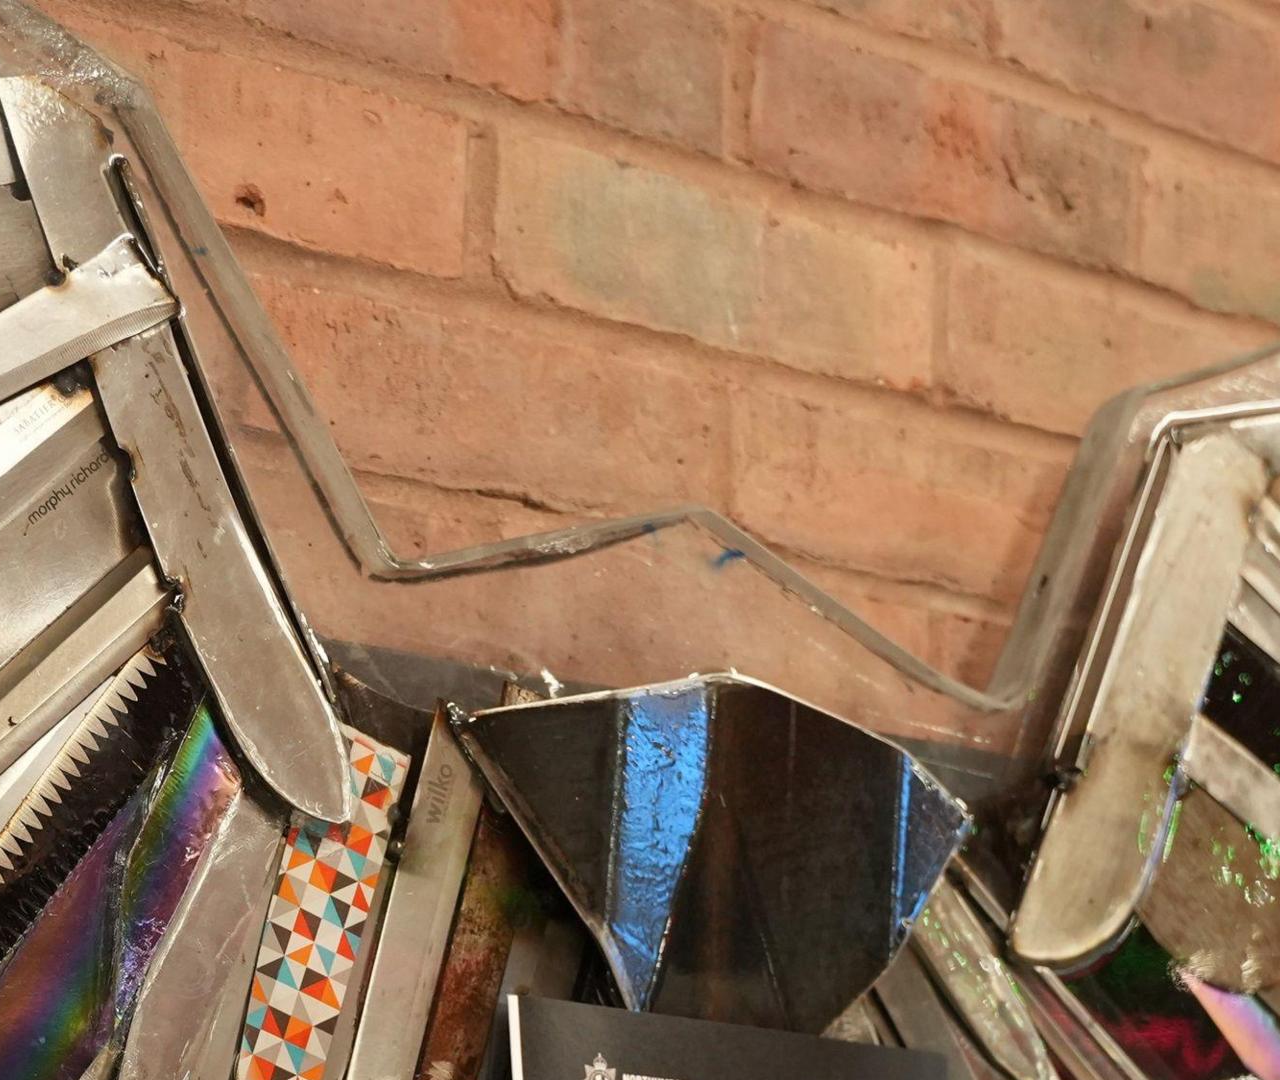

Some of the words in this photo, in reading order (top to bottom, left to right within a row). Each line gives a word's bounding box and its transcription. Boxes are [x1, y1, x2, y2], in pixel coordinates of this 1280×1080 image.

[28, 485, 73, 525] morphy
[70, 449, 111, 489] richard
[426, 763, 453, 824] wilko
